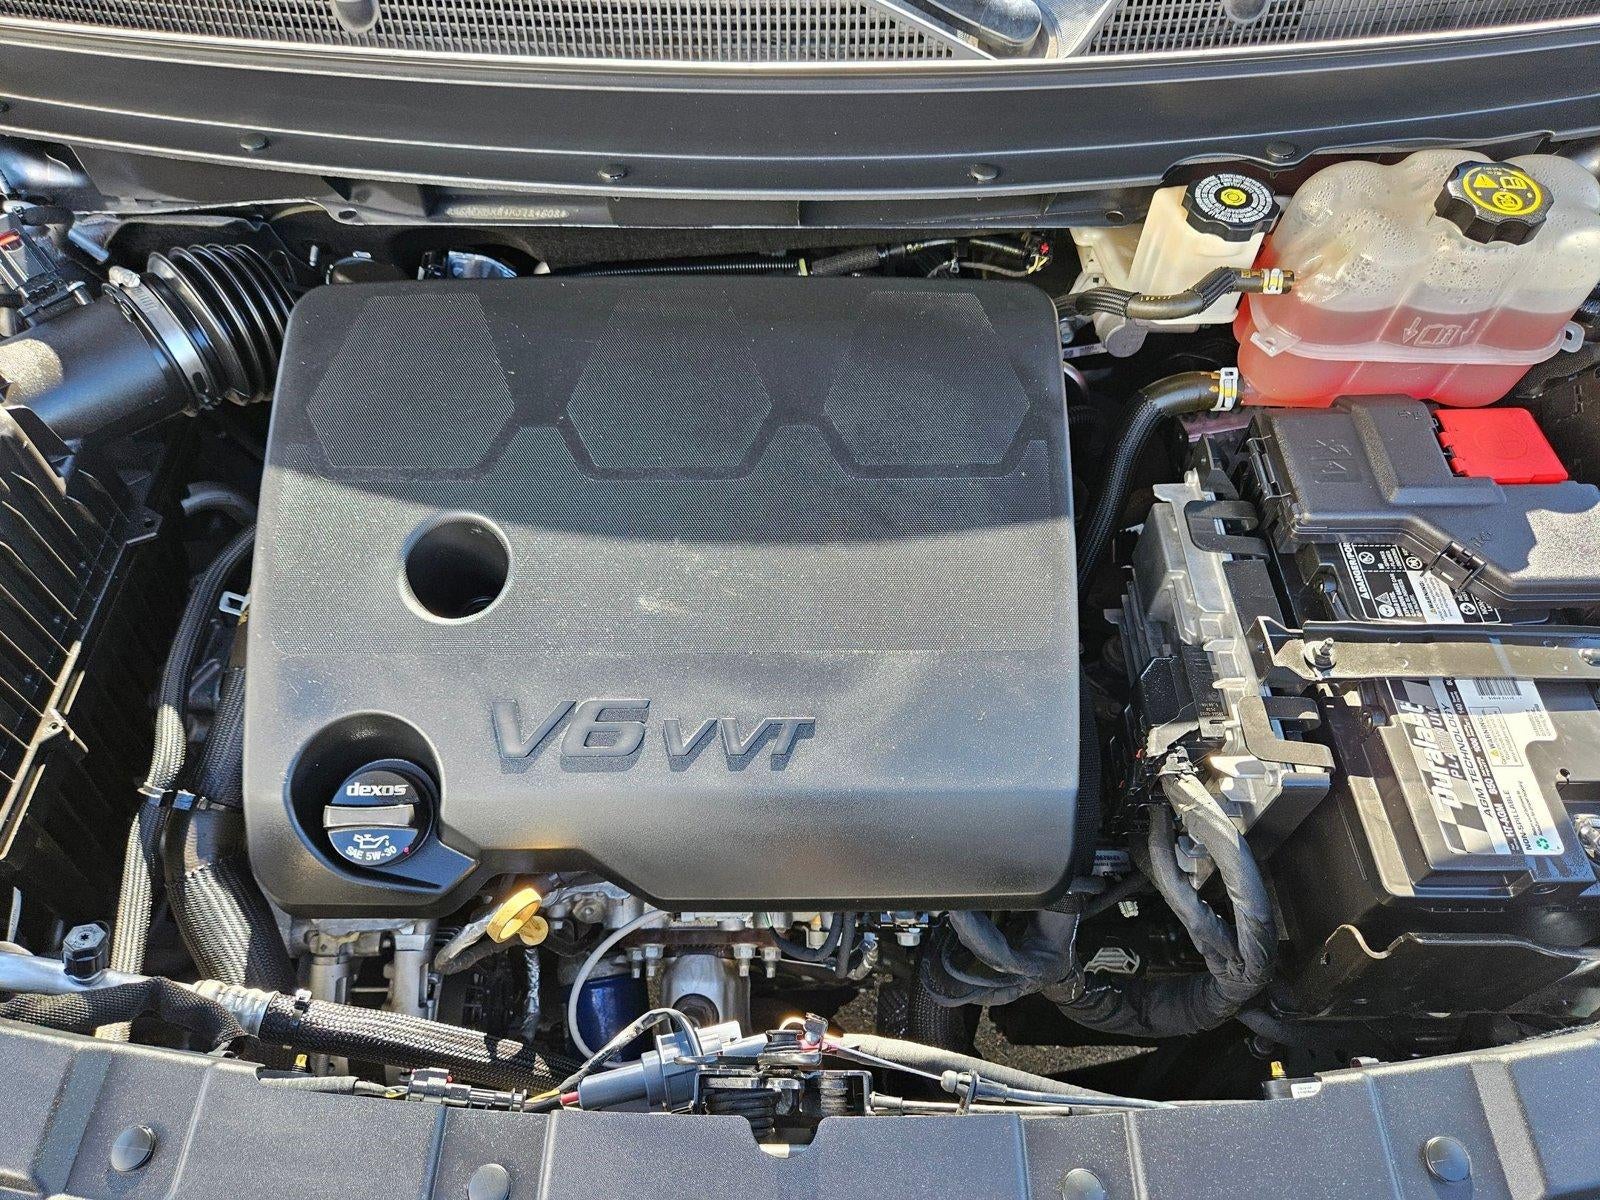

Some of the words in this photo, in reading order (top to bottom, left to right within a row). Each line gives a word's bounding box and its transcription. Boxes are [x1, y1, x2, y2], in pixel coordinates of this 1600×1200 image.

[492, 698, 650, 772] V6
[664, 717, 816, 772] VVT
[1400, 701, 1463, 810] Duralast
[1442, 703, 1479, 783] TECHNOLOGY
[346, 782, 409, 797] dexos
[1475, 788, 1493, 818] AGM
[345, 846, 363, 860] SAE
[365, 847, 398, 861] 5W-30
